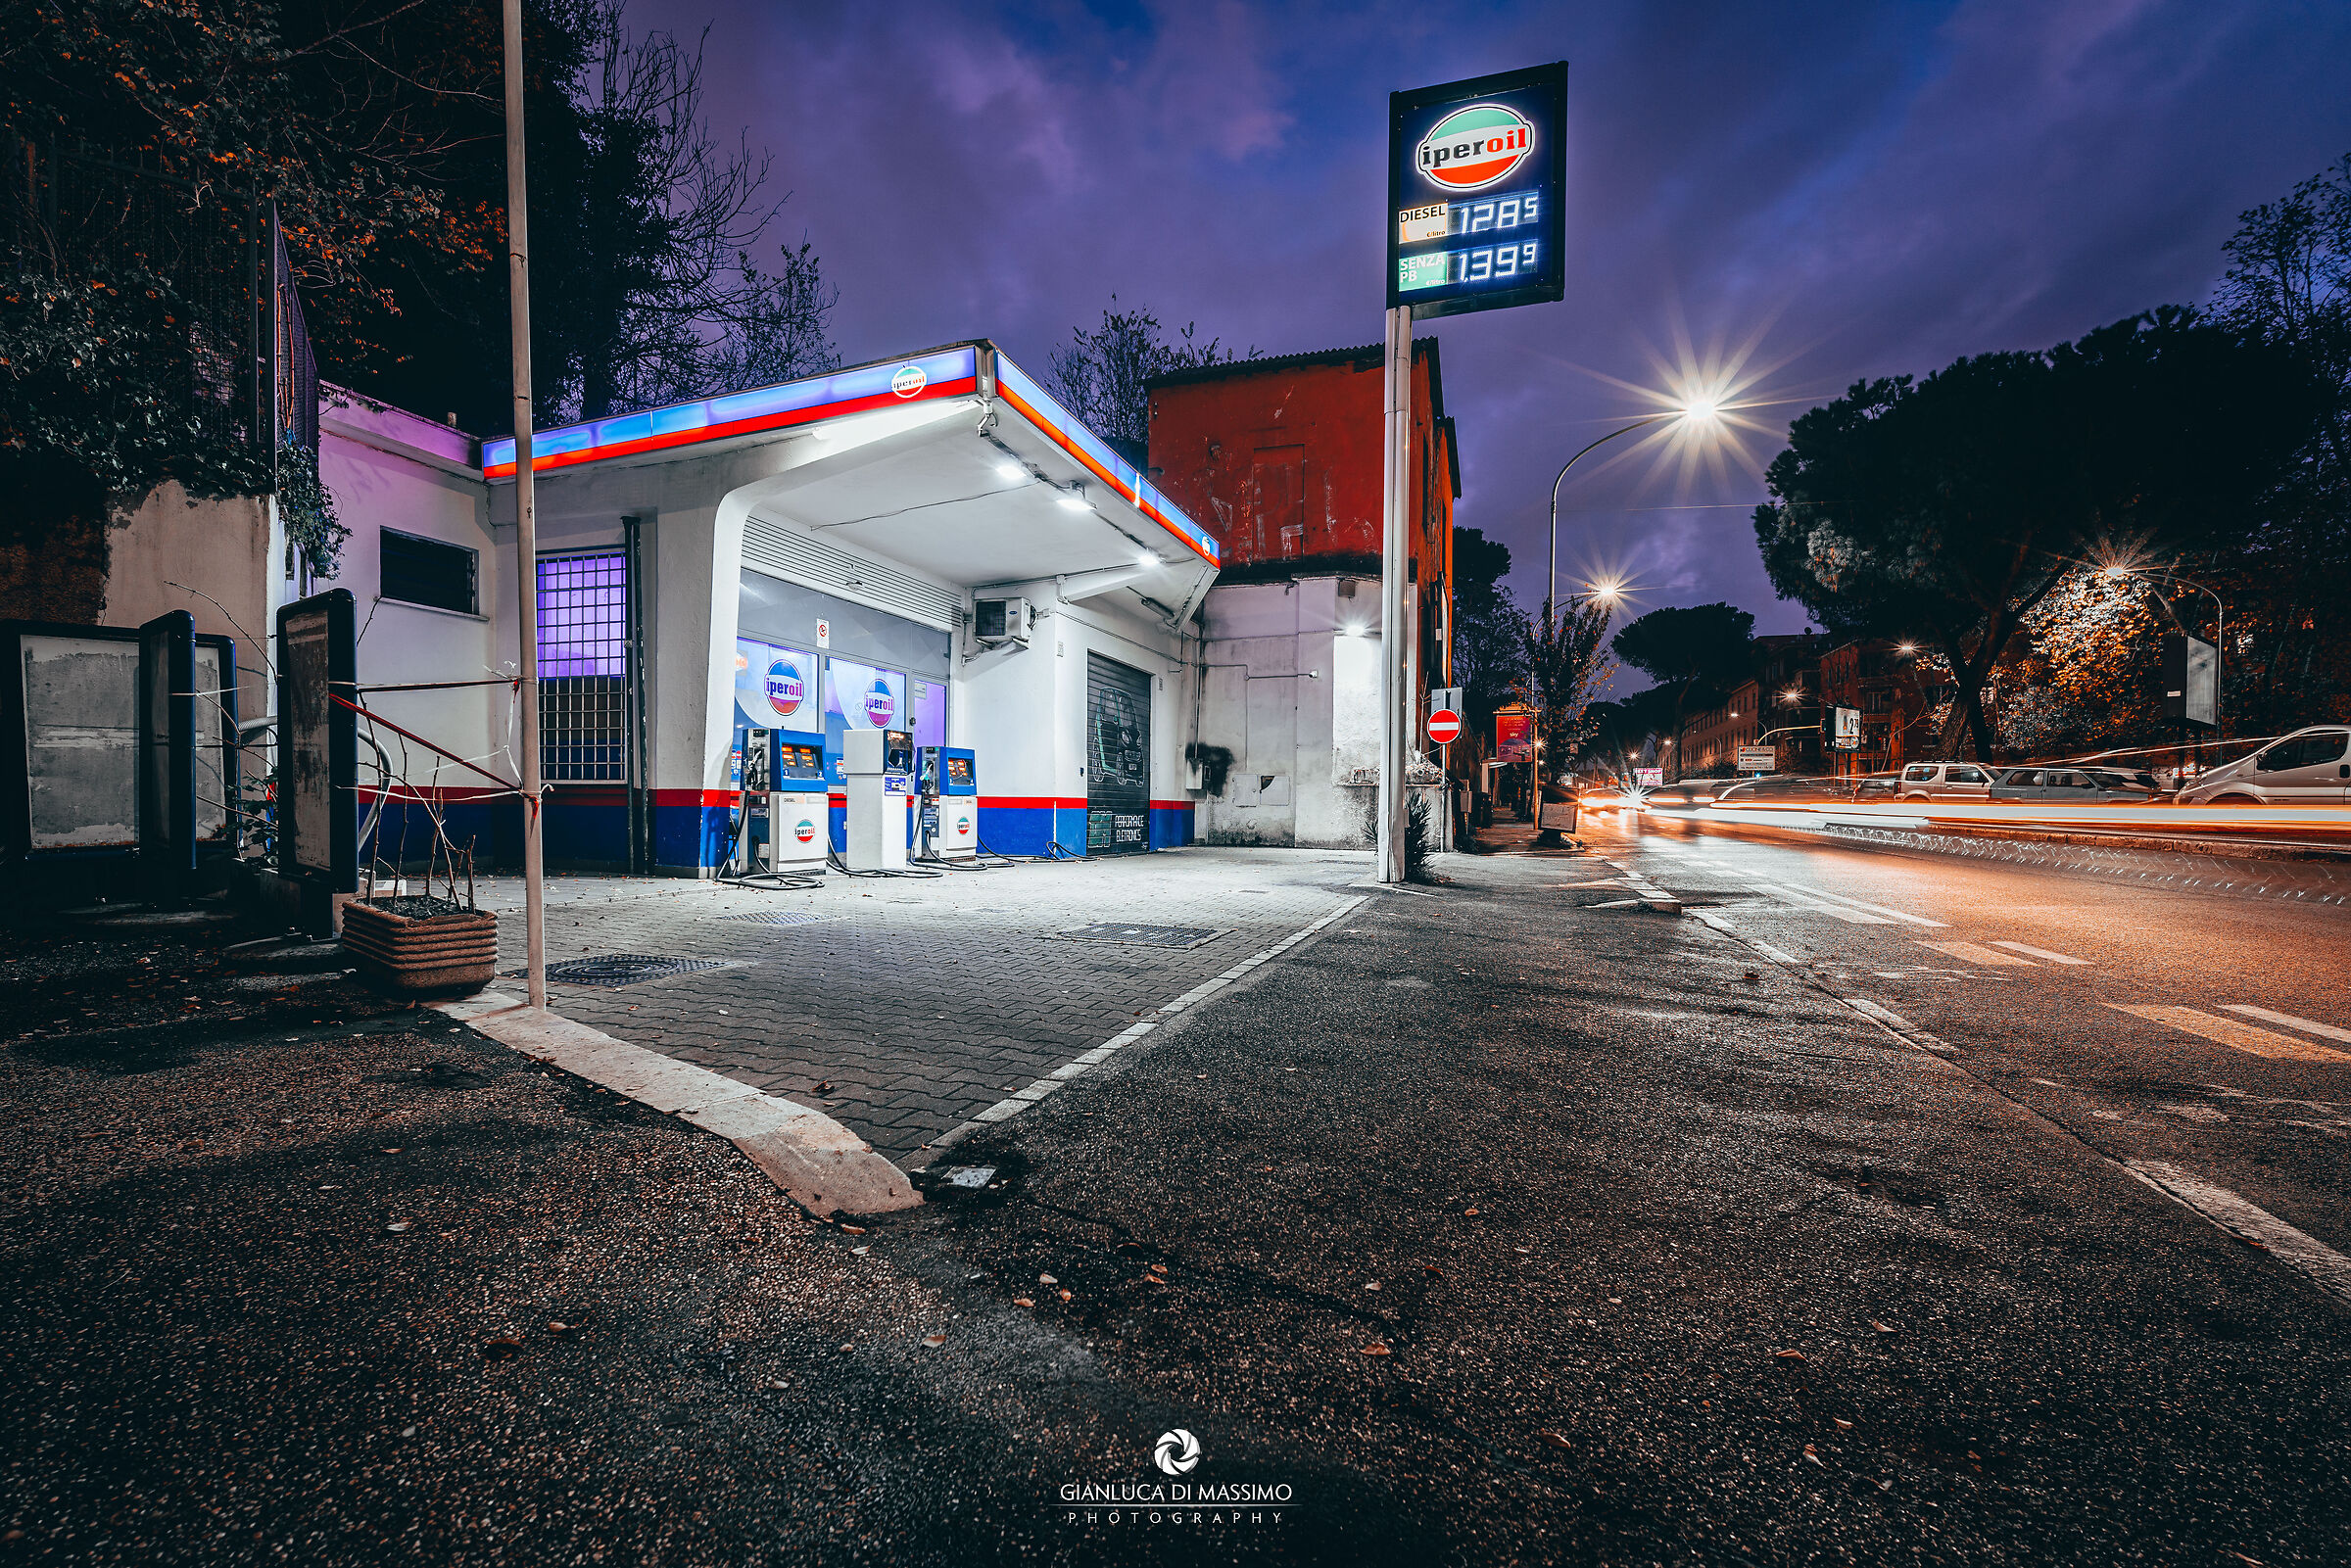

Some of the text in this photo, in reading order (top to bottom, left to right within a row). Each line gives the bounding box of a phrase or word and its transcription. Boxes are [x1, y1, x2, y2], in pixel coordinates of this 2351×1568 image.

[1422, 127, 1527, 168] iperoil
[1400, 205, 1445, 222] DIESEL
[1400, 253, 1445, 270] SENZA
[1400, 269, 1418, 283] PB
[765, 676, 803, 698] iperoil
[865, 693, 893, 713] iperoil
[794, 827, 815, 836] iperoil
